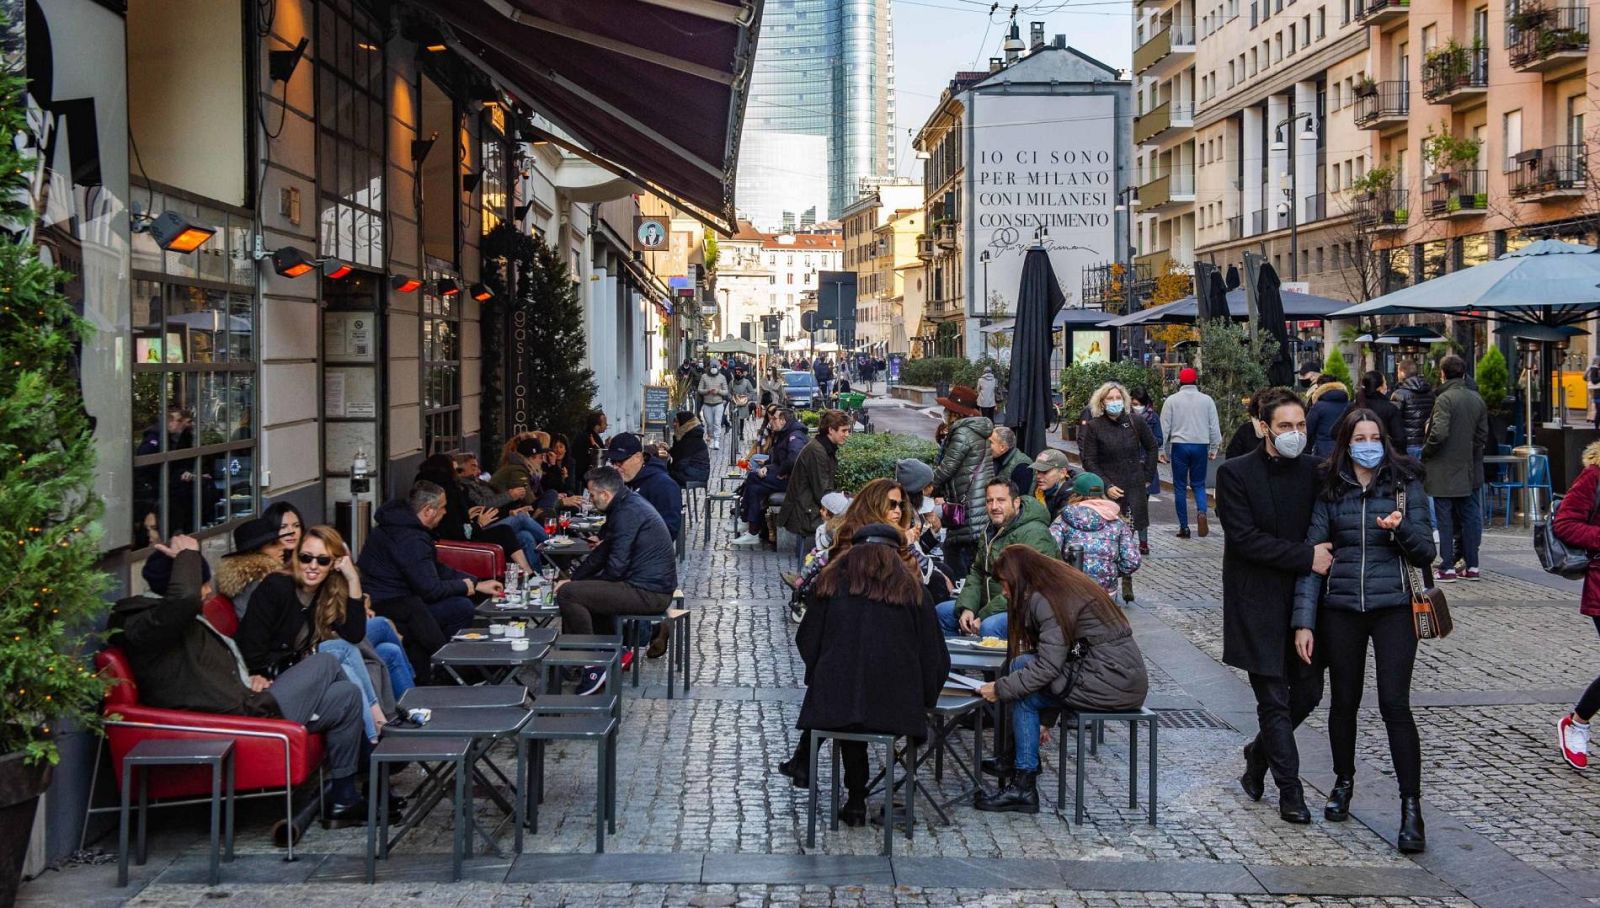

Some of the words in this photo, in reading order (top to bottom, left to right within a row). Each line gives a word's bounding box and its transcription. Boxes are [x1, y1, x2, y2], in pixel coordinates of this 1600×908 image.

[981, 150, 1003, 165] IO
[1016, 150, 1037, 165] CI
[1050, 150, 1109, 165] SONO
[981, 171, 1016, 186] PER
[1027, 171, 1109, 186] MILANO
[979, 192, 1012, 206] CON
[1016, 192, 1021, 206] I
[1026, 192, 1106, 206] MILANESI
[979, 213, 1012, 228] CON
[1014, 213, 1109, 228] SENTIMENTO
